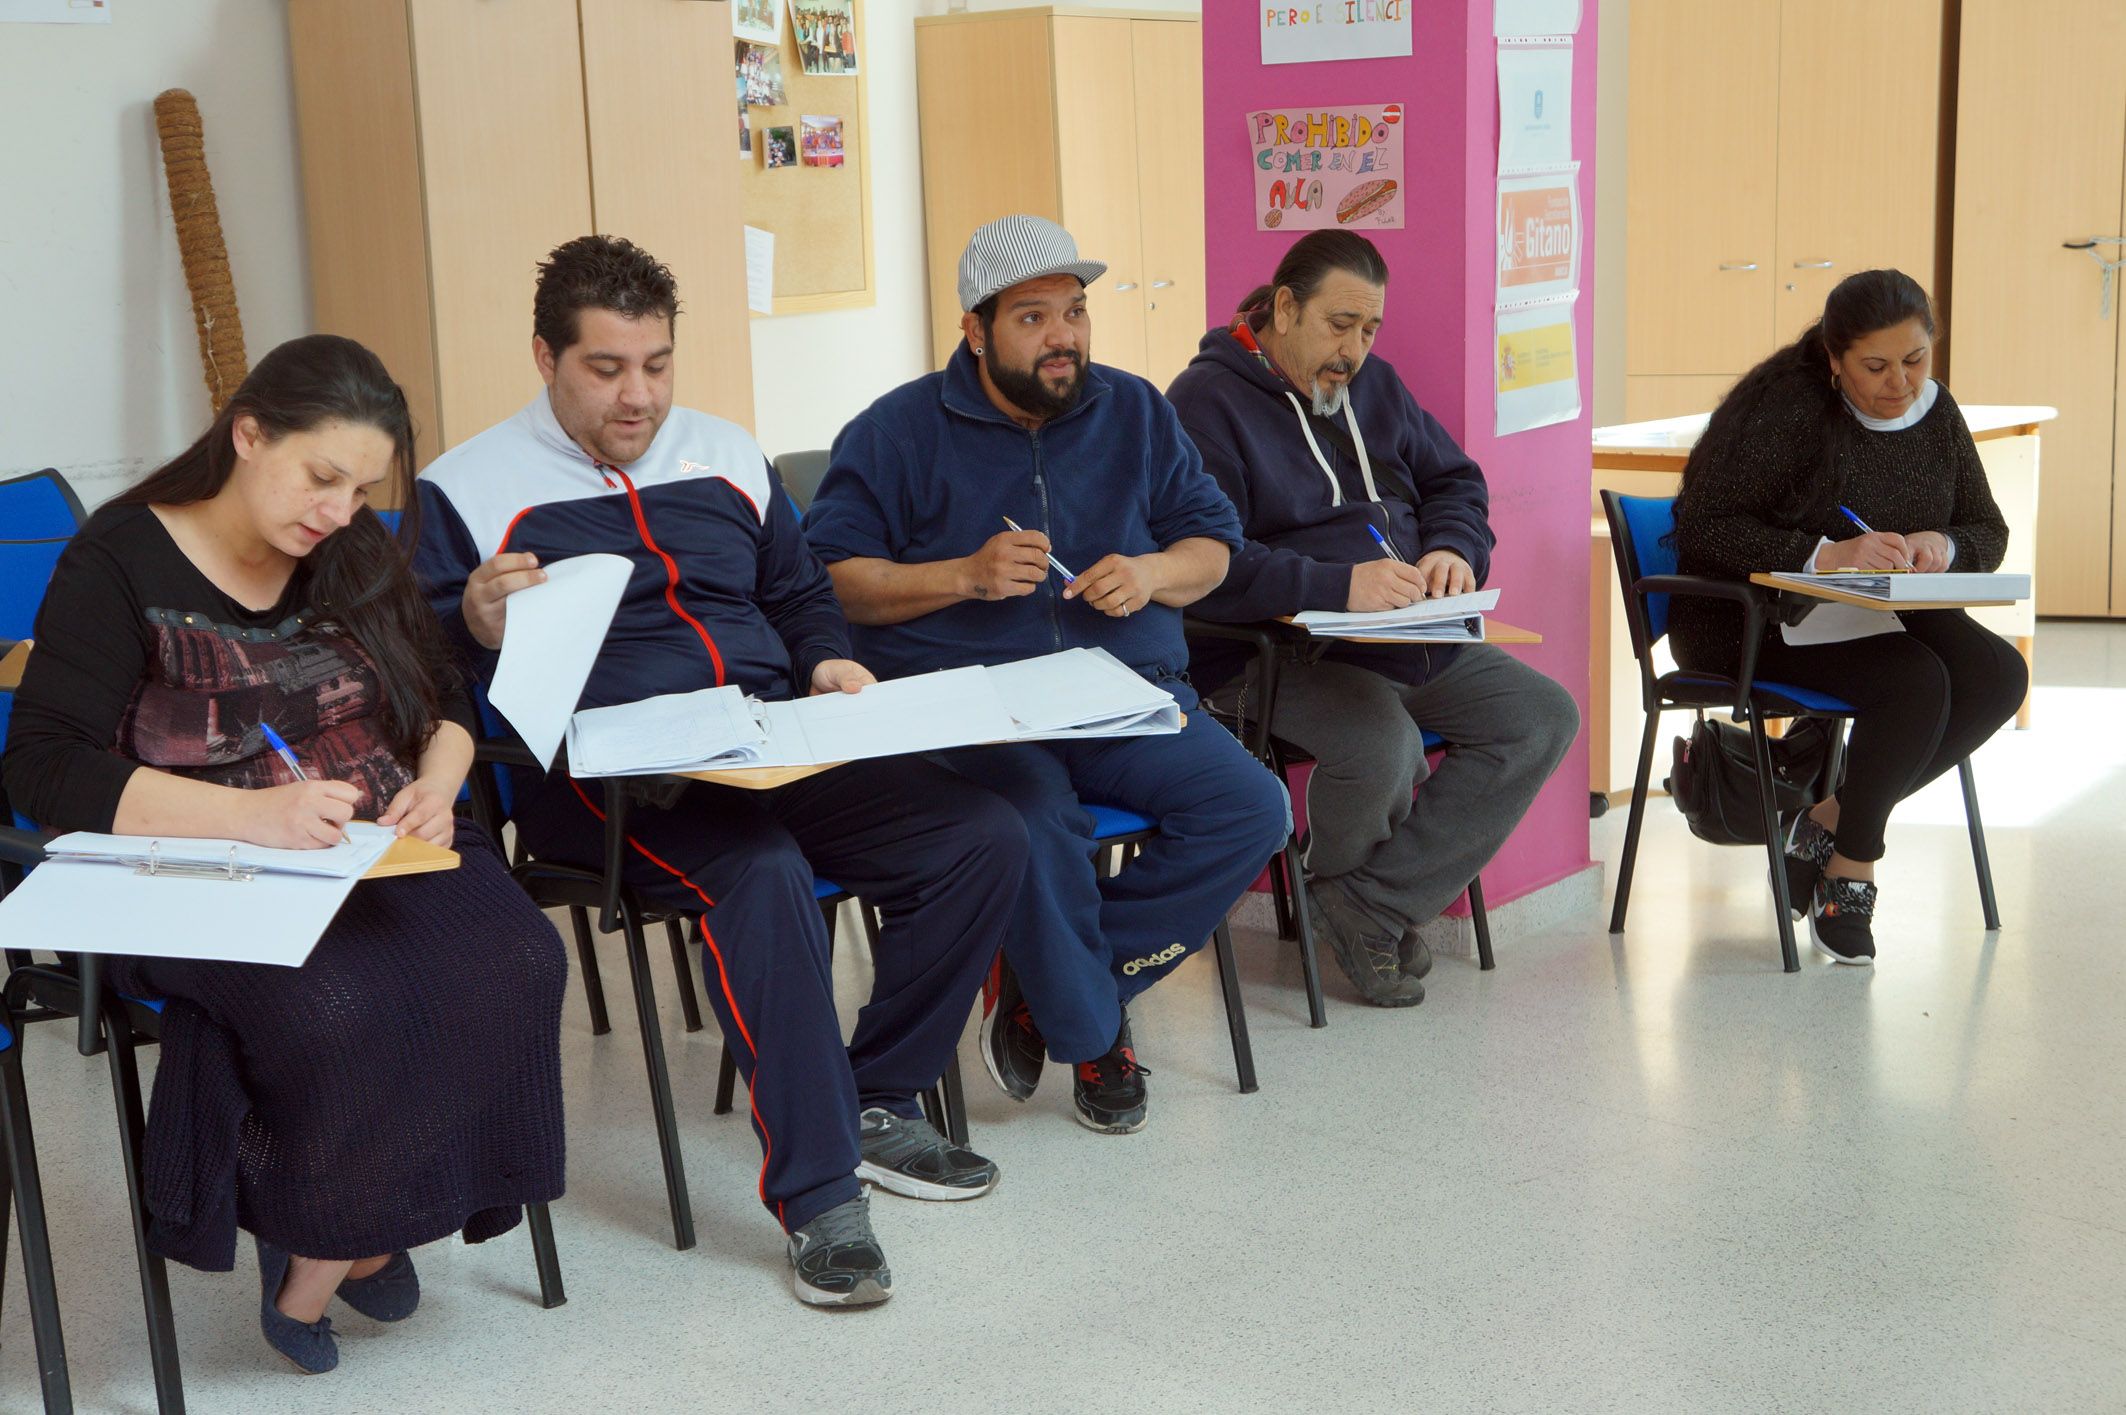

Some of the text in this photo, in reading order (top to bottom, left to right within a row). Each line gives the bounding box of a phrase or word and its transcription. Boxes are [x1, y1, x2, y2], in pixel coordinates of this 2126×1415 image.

[1266, 8, 1310, 27] PERO
[1253, 112, 1389, 149] PROHIBIDO
[1257, 148, 1323, 173] COMER
[1328, 150, 1356, 173] EN
[1269, 178, 1324, 211] AULA
[1526, 217, 1570, 258] Gitano
